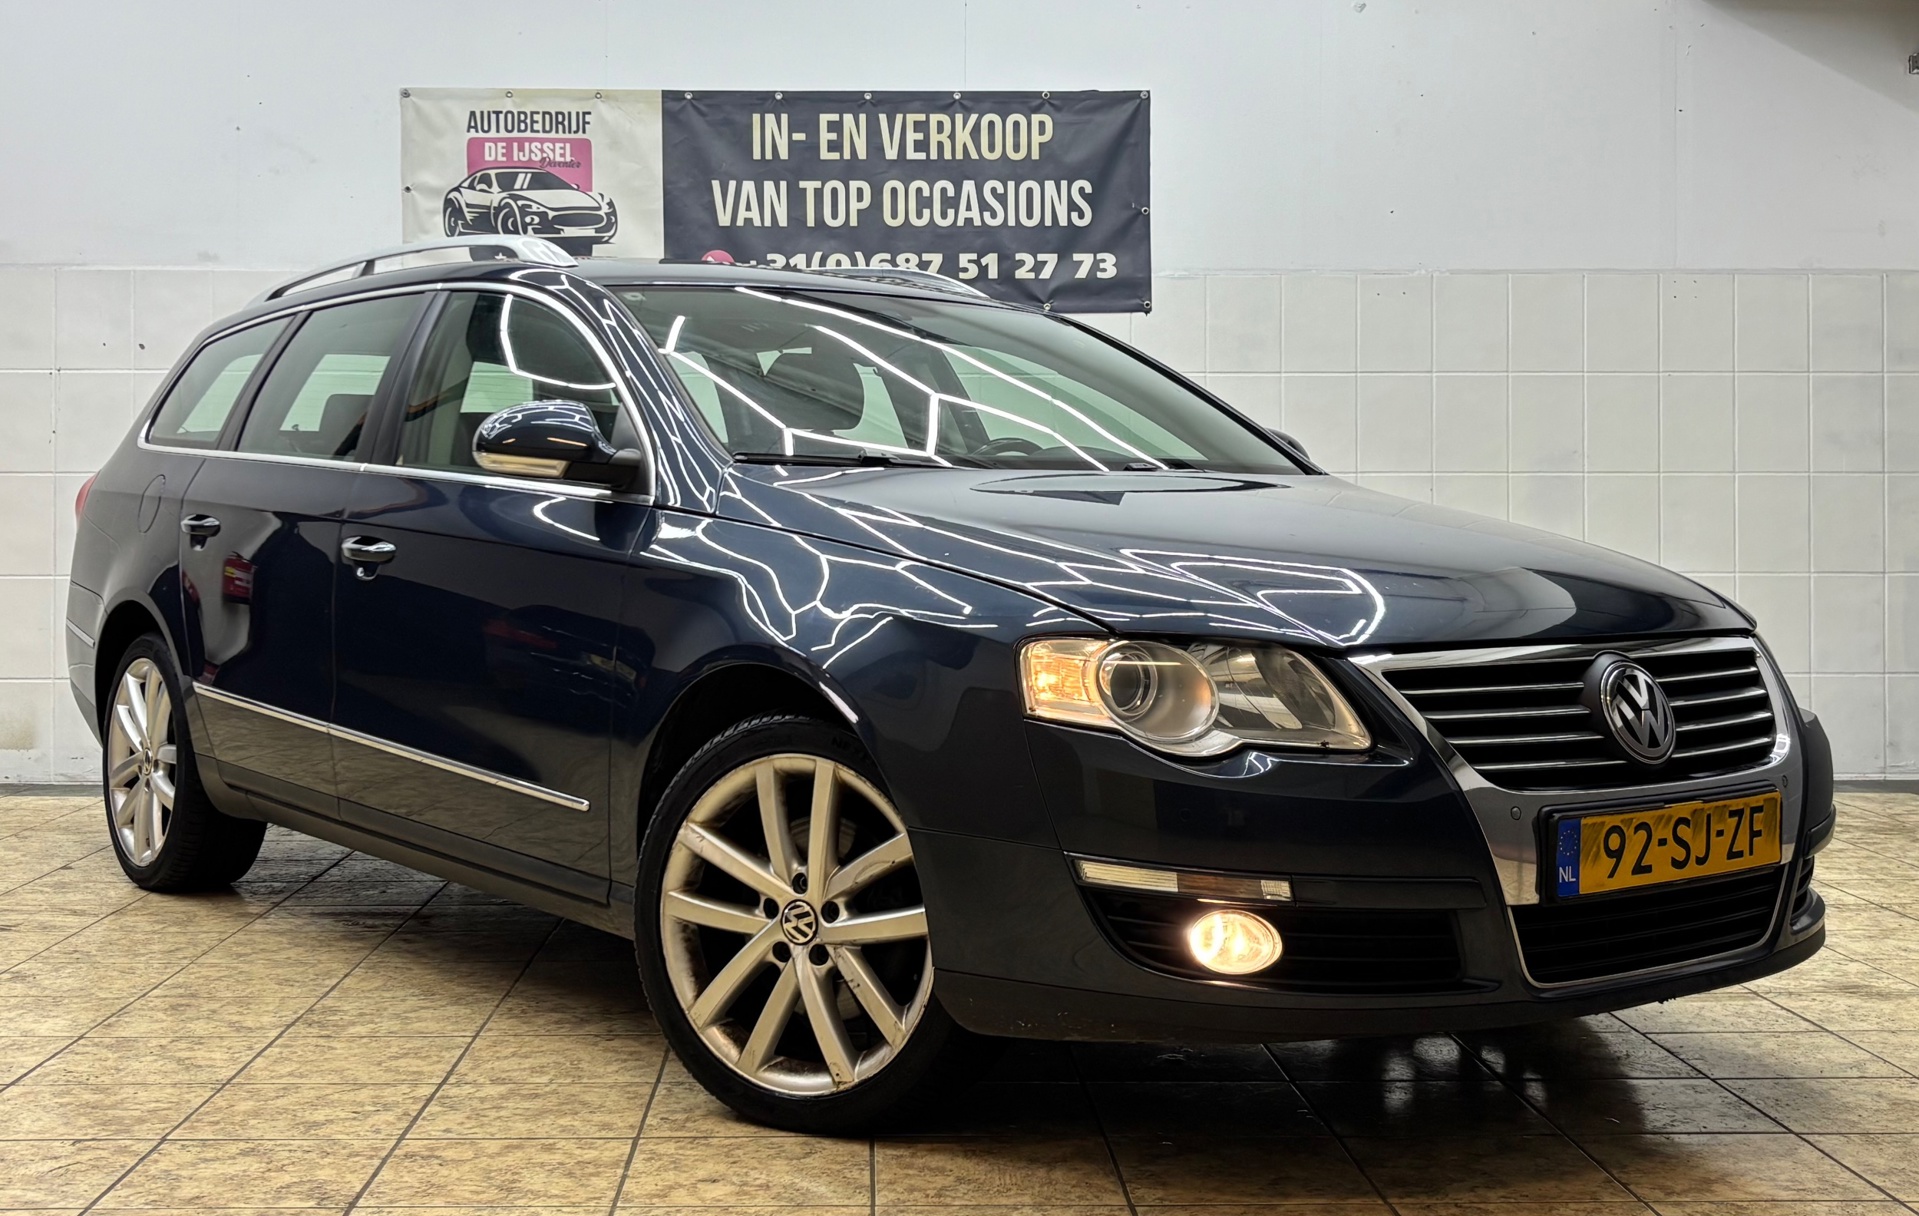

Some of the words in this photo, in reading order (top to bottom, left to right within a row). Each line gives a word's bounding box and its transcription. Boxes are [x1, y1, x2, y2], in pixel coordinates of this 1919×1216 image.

[466, 110, 592, 135] AUTOBEDRIJF
[752, 113, 806, 160] IN-
[819, 113, 867, 160] EN
[879, 113, 1054, 160] VERKOOP
[484, 142, 507, 161] DE
[513, 142, 574, 162] IJSSEL
[540, 157, 582, 168] Deventer
[711, 180, 788, 227] VAN
[799, 180, 872, 227] TOP
[882, 180, 1093, 227] OCCASIONS
[958, 253, 999, 279] 51
[1014, 253, 1058, 279] 27
[1073, 253, 1118, 279] 73
[1602, 805, 1765, 879] 92-SJ-ZF
[1558, 866, 1577, 883] NL
